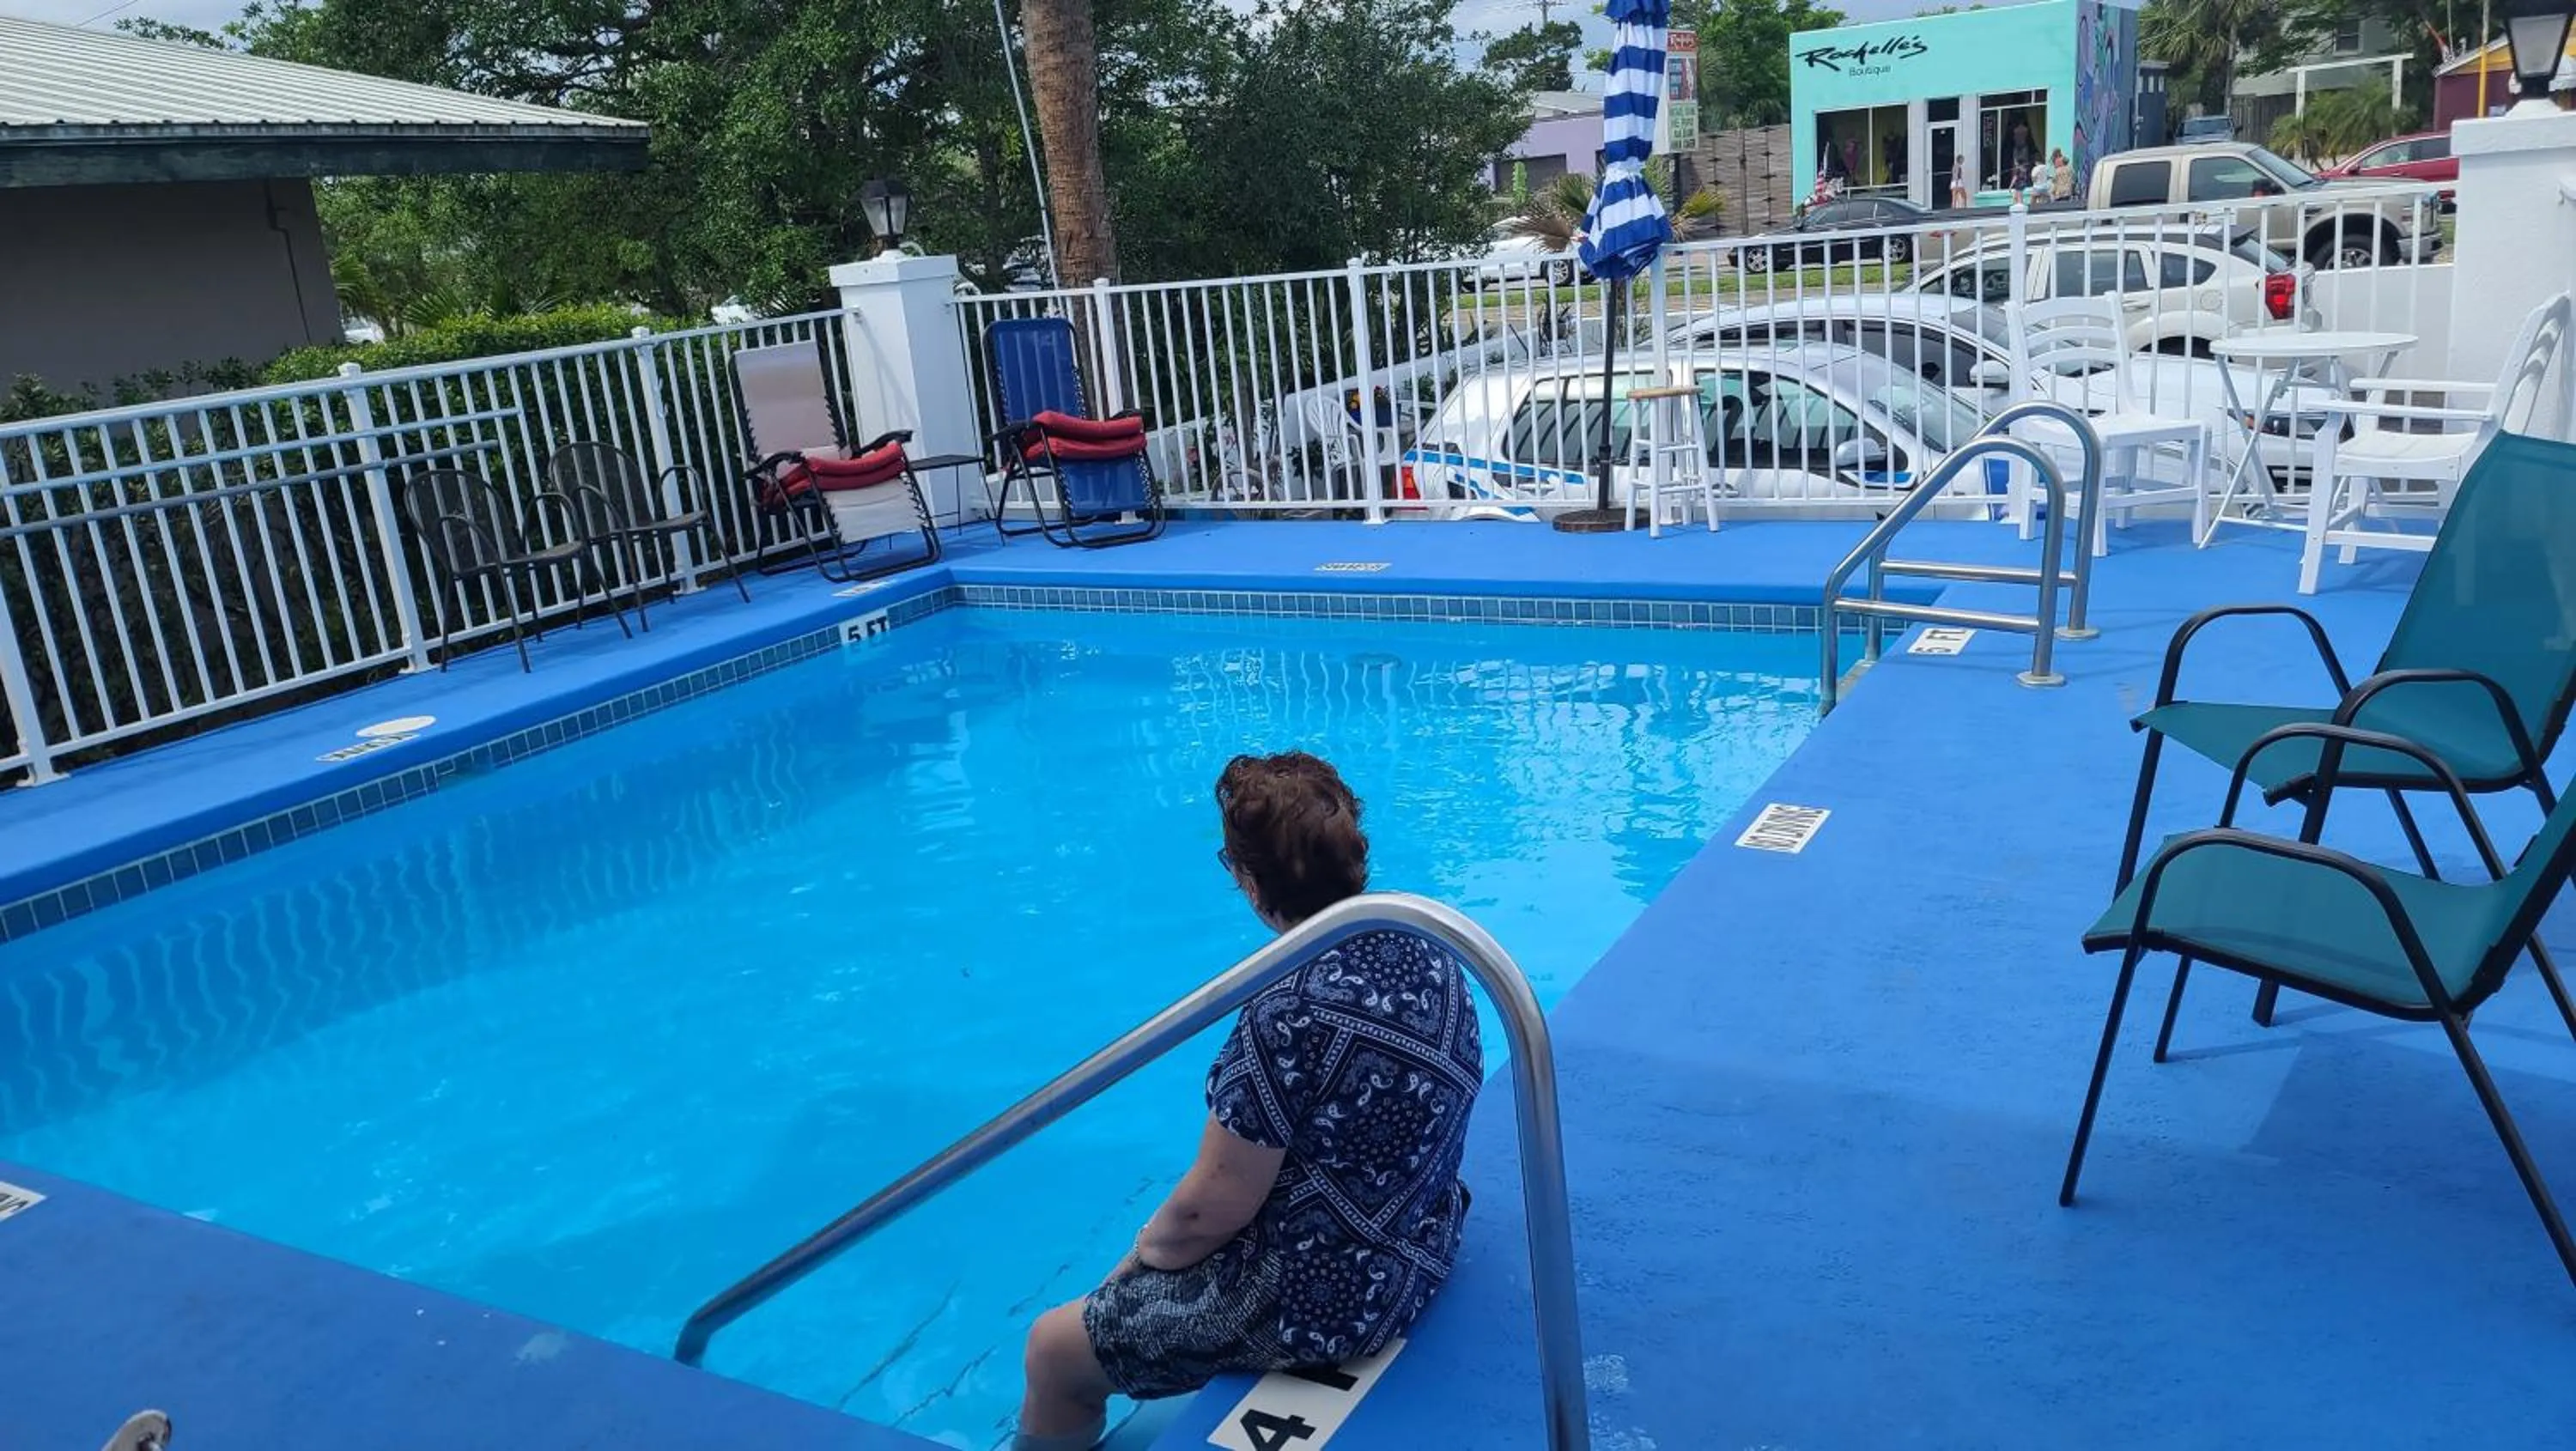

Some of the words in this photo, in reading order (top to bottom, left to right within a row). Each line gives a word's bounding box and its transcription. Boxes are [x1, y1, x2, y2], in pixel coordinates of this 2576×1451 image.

[848, 623, 863, 643] 5
[866, 615, 888, 638] FT
[1926, 629, 1966, 641] FT
[1240, 1409, 1316, 1451] 4
